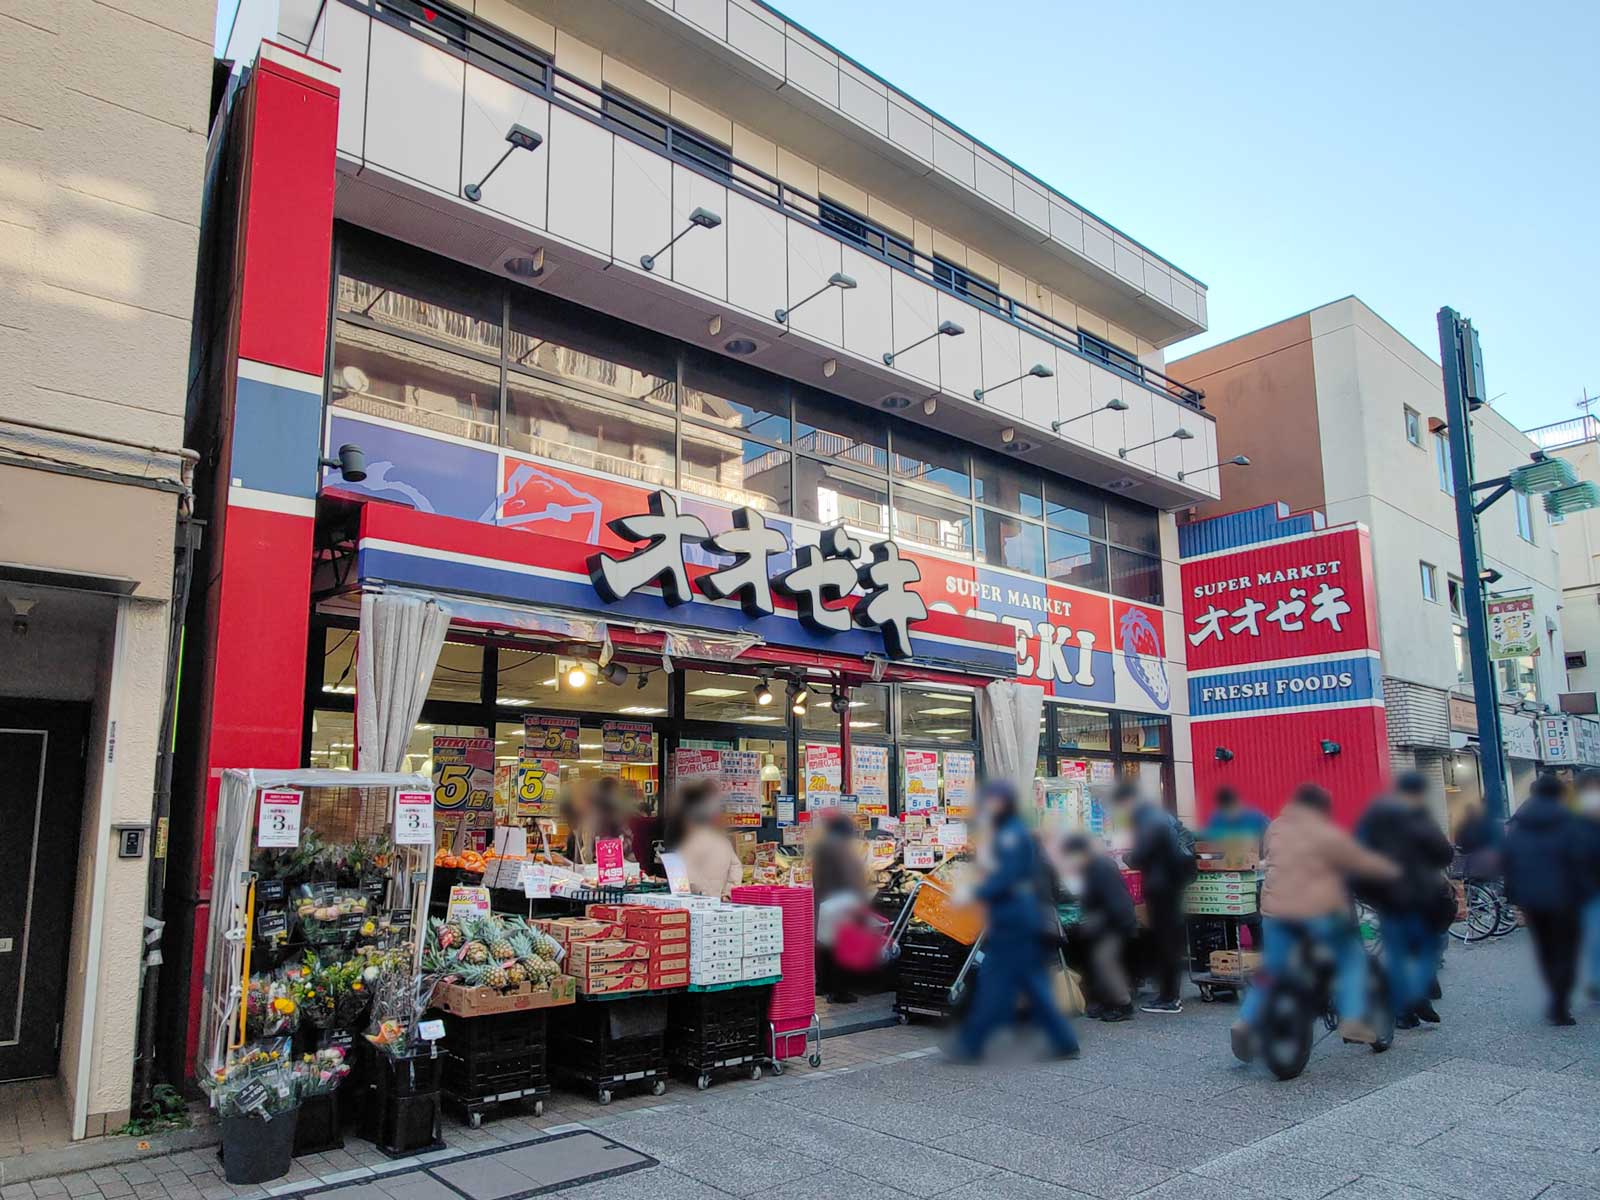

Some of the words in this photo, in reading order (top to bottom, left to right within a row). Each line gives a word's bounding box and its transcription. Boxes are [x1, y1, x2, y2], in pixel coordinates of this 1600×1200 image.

[587, 489, 928, 660] オオゼキ
[1193, 575, 1253, 599] SUPER
[1257, 560, 1342, 586] MARKET
[945, 575, 1003, 603] SUPER
[1007, 590, 1072, 617] MARKET
[1188, 583, 1352, 648] オオゼキ
[1202, 681, 1269, 703] FRESH
[1275, 672, 1353, 695] FOODS
